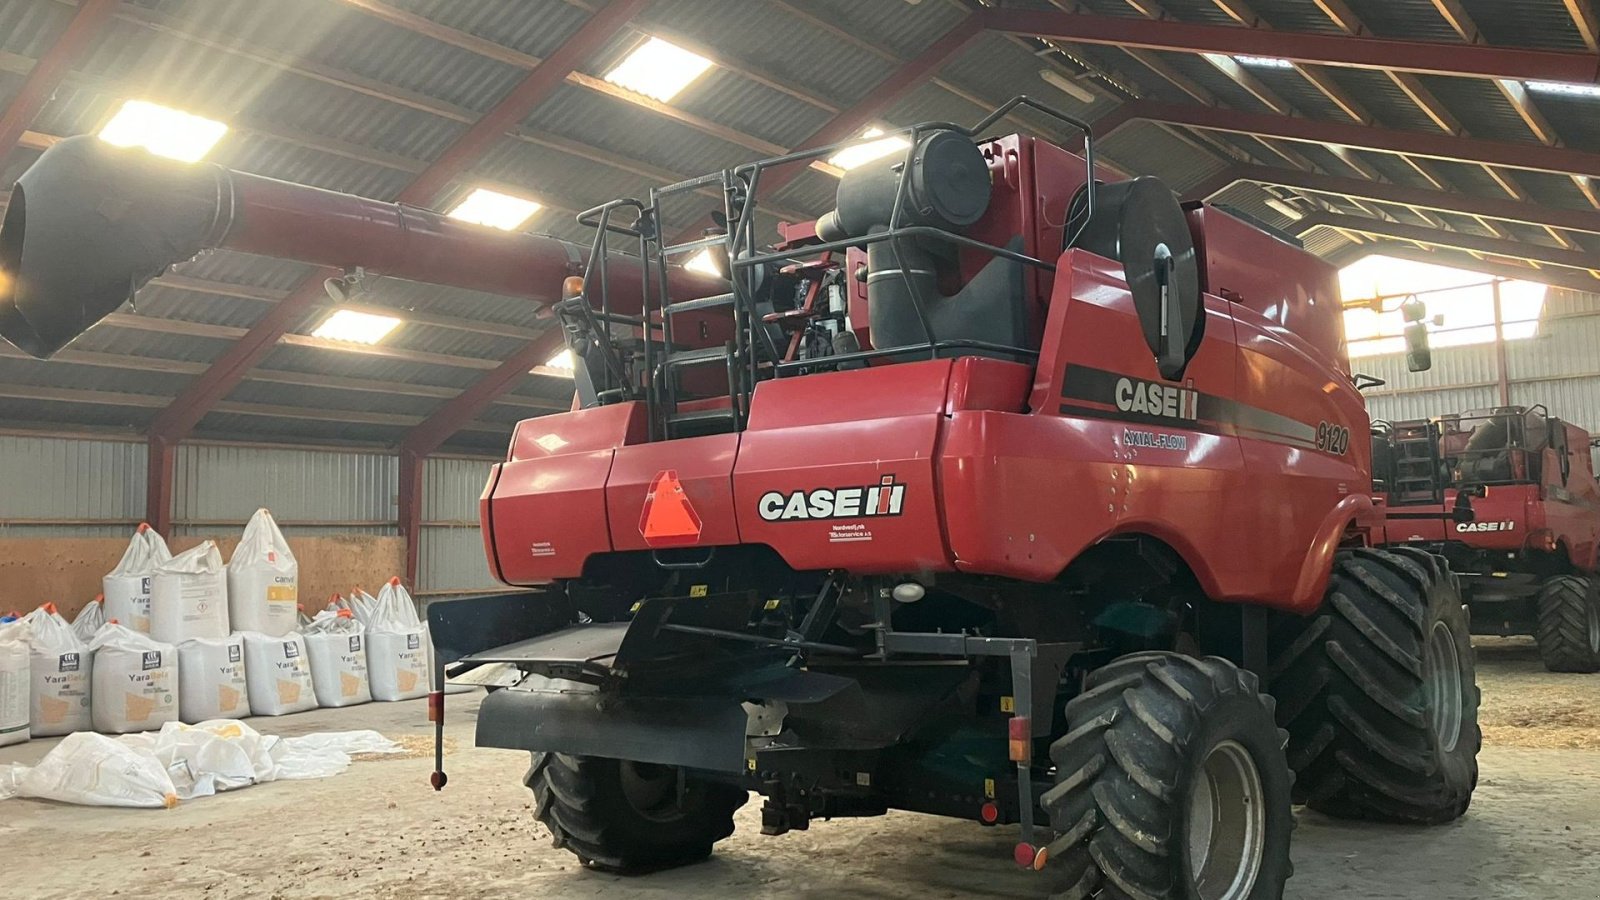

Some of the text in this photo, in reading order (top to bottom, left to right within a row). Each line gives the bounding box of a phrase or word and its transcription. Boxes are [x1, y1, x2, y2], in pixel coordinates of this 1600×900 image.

[1115, 377, 1178, 417] CASE
[1123, 427, 1187, 450] AXIAL-FLOW
[1317, 420, 1349, 456] 9120
[758, 488, 862, 521] CASE
[1456, 522, 1498, 532] CASE
